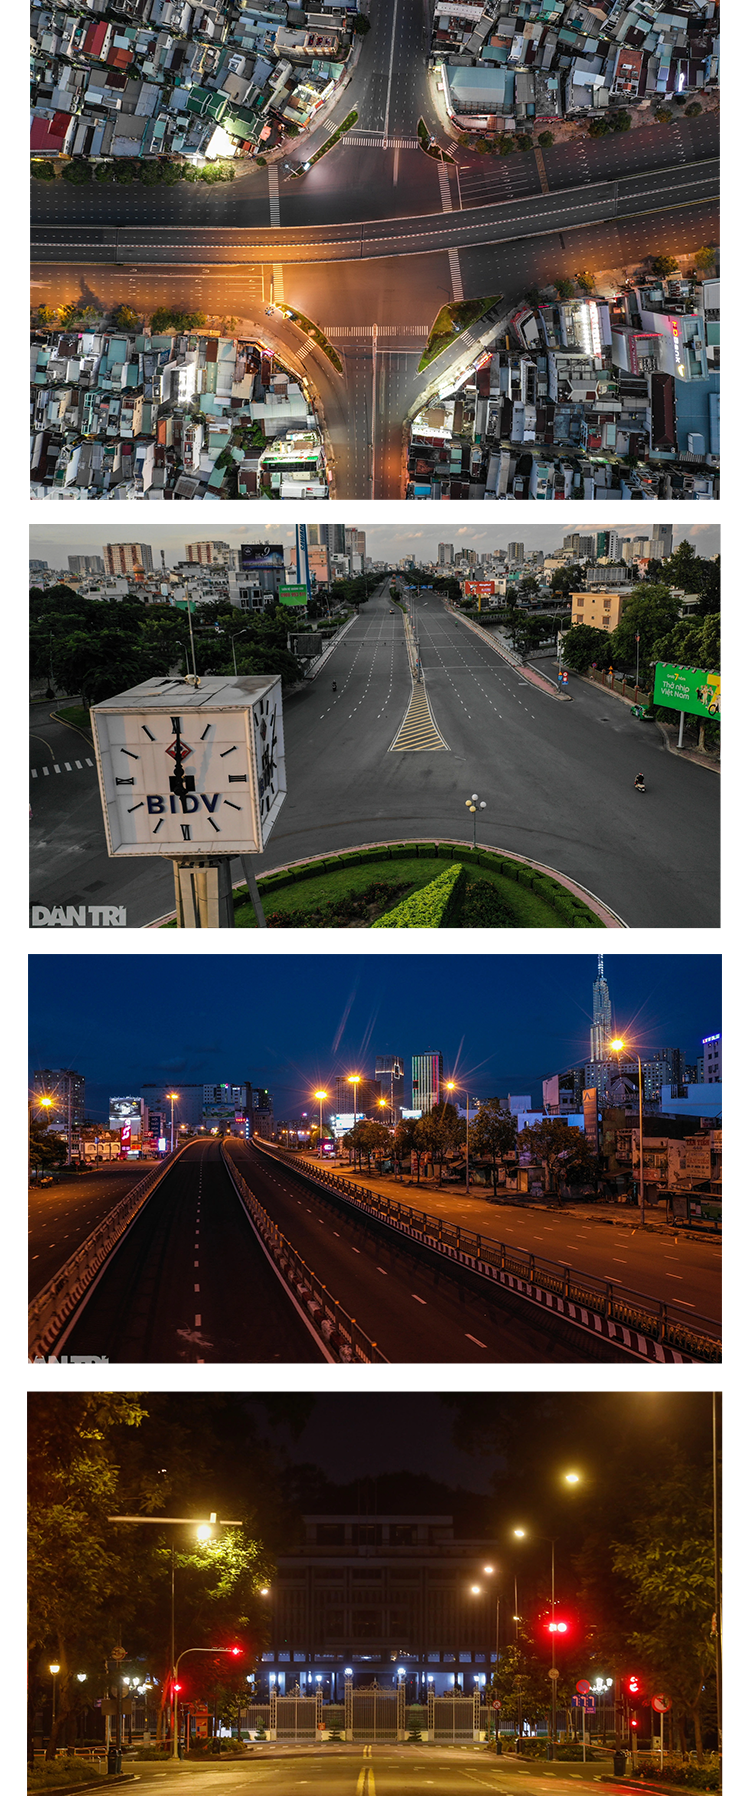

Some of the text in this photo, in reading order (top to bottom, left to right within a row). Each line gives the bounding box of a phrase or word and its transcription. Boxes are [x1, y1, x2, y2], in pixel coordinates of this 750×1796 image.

[674, 673, 679, 681] 7
[661, 687, 690, 700] Việt Nam
[146, 793, 219, 814] BIDV
